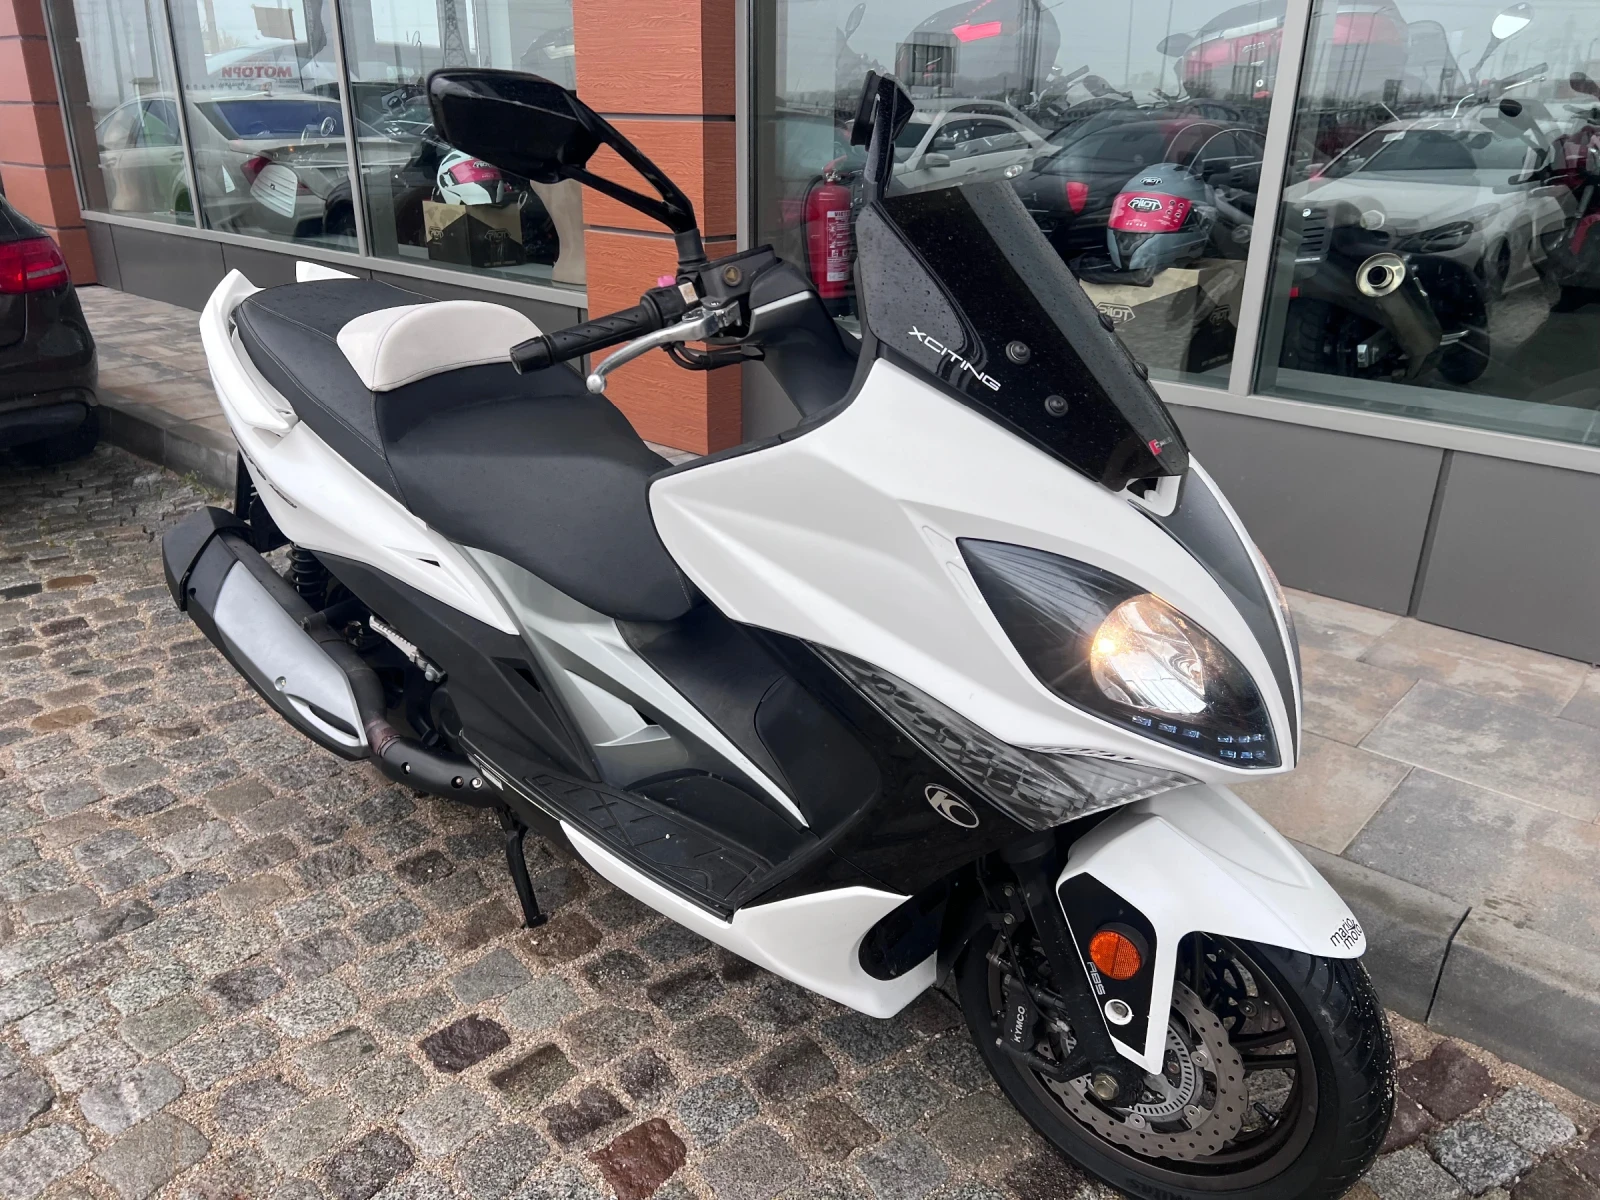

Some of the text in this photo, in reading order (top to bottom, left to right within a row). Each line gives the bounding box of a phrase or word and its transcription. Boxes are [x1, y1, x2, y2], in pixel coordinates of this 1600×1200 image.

[1130, 198, 1161, 211] PILOT
[908, 325, 1001, 392] XCITING
[1330, 918, 1355, 947] mario
[1086, 961, 1106, 996] ABS
[1013, 1005, 1026, 1043] KYMCO
